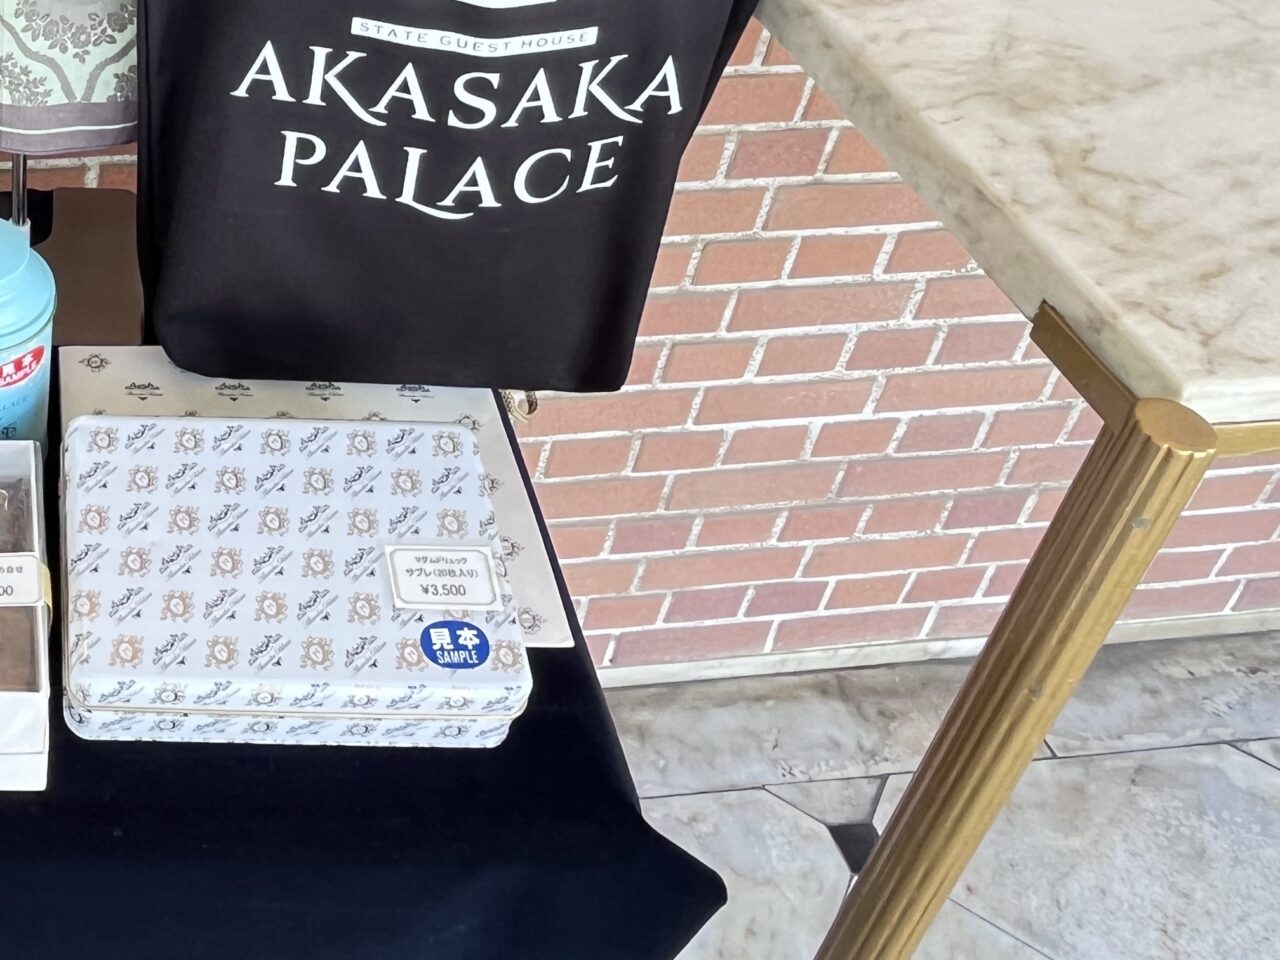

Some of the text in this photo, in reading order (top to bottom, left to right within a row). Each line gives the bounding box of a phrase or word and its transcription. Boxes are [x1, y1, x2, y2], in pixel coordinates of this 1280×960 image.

[359, 22, 589, 53] STATE GUEST HOUSE
[229, 40, 684, 130] AKASAKA
[273, 129, 625, 221] PALACE
[420, 583, 467, 597] ¥3,500
[429, 627, 480, 650] 見本
[436, 649, 479, 665] SAMPLE
